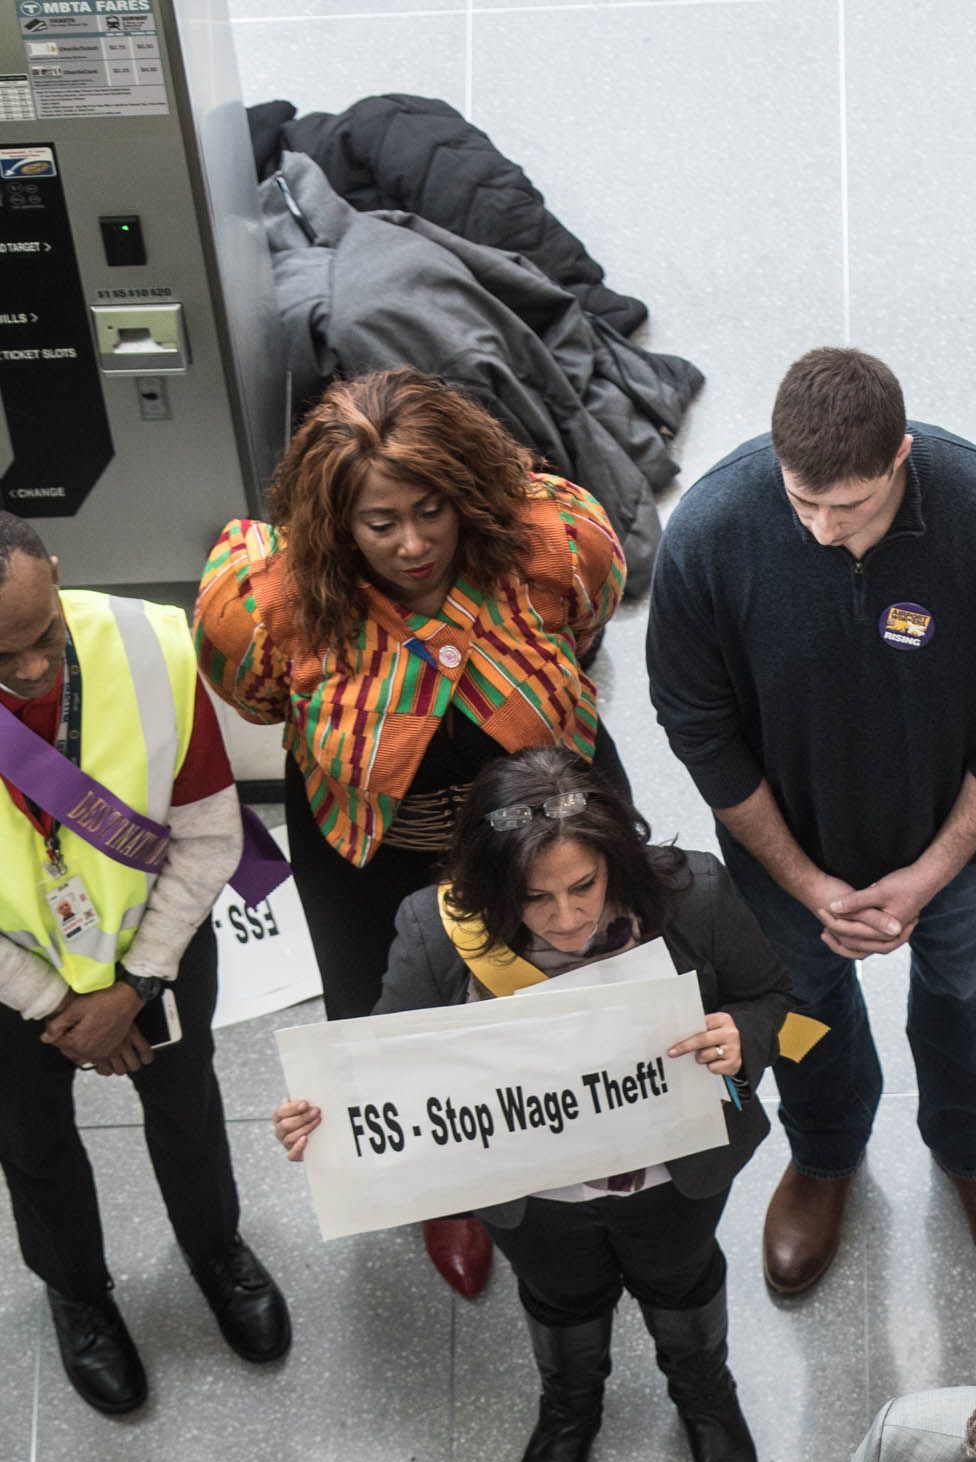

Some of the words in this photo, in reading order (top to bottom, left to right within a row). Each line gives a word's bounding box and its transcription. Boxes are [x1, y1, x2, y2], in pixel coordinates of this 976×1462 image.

[44, 2, 92, 14] MBTA
[96, 0, 150, 12] FARES
[7, 241, 40, 252] TARGET
[2, 349, 40, 361] TICKET
[41, 348, 77, 359] SLOTS
[18, 487, 65, 498] CHANGE
[884, 631, 921, 646] RISING
[348, 1102, 404, 1157] FSS
[427, 1097, 494, 1149] Stop
[496, 1086, 578, 1134] Wage
[582, 1057, 668, 1114] Theft!
